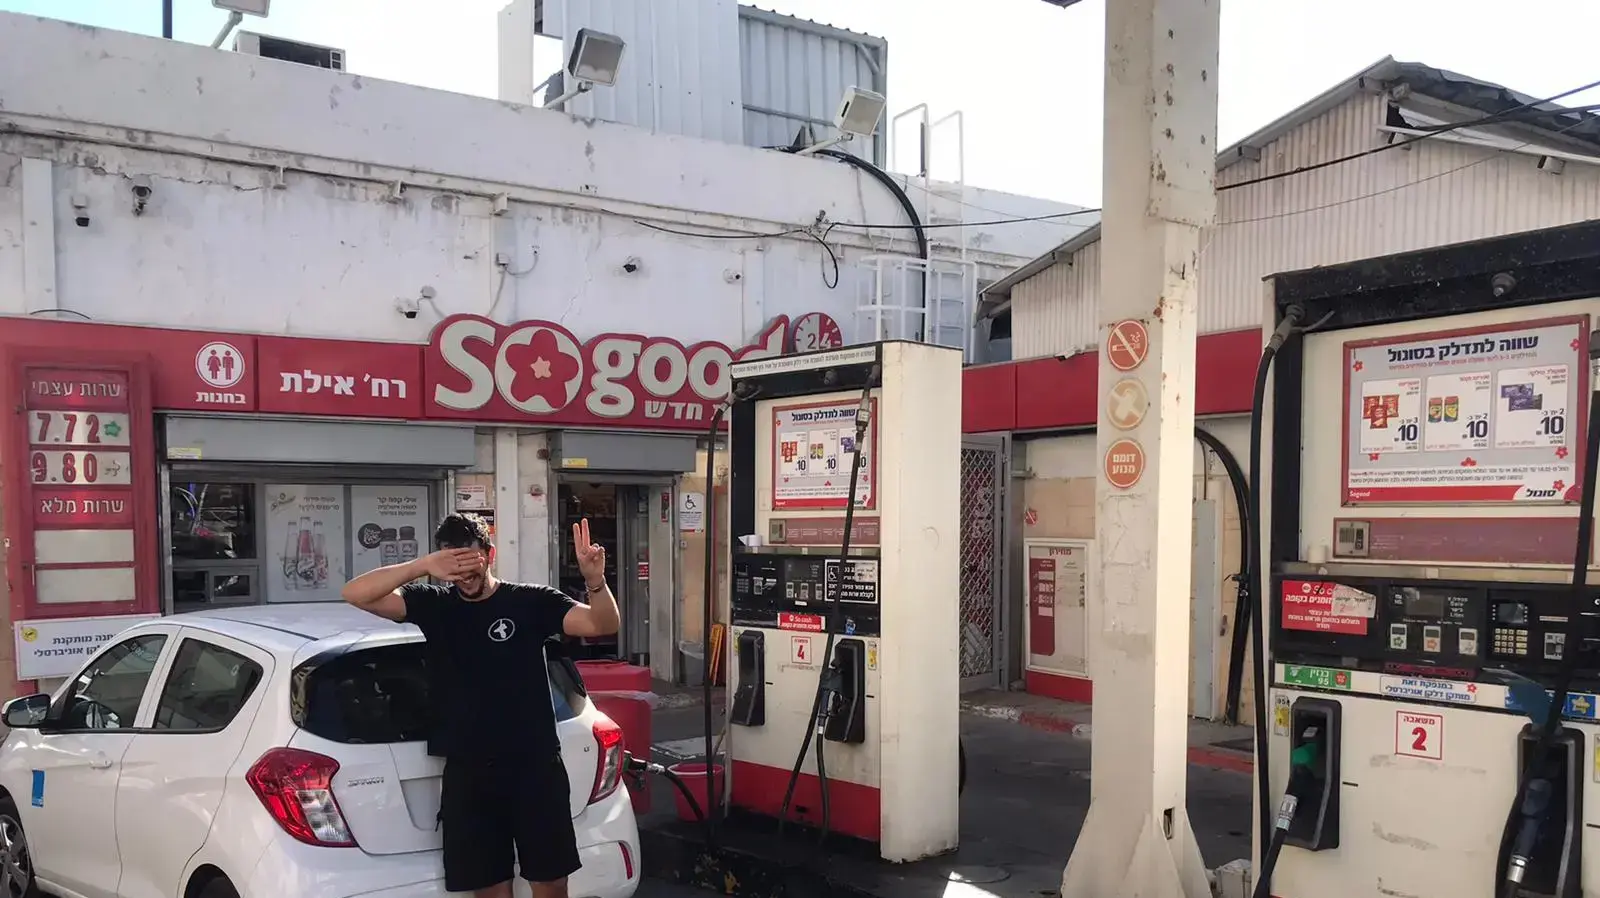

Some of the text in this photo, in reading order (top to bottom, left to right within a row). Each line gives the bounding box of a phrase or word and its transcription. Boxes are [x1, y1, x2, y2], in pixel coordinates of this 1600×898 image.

[1388, 336, 1539, 362] שווה לתדלק בסונול
[32, 381, 120, 396] שרות עצמי
[280, 370, 406, 398] רח' אילת
[196, 392, 246, 404] בחנות
[645, 400, 703, 420] חדש
[792, 409, 855, 421] שווה לתדלק בסונול
[37, 412, 100, 443] 7.72
[1112, 453, 1136, 463] דומם
[32, 452, 98, 483] 9.80
[1112, 464, 1135, 475] מנוע
[1525, 488, 1556, 497] סונול
[42, 497, 123, 513] שרות מלא
[1285, 594, 1308, 604] בקופה
[1309, 596, 1332, 605] זומנים
[52, 635, 92, 645] מותקנת
[34, 647, 83, 657] אוניברסלי
[797, 645, 804, 659] 4
[1310, 669, 1329, 678] בנזין
[1317, 678, 1329, 686] 95
[1420, 680, 1453, 689] במנפקת
[1385, 685, 1423, 694] אוניברסלי
[1424, 689, 1444, 698] דלקן
[1403, 715, 1435, 725] משאבה
[1412, 727, 1427, 751] 2
